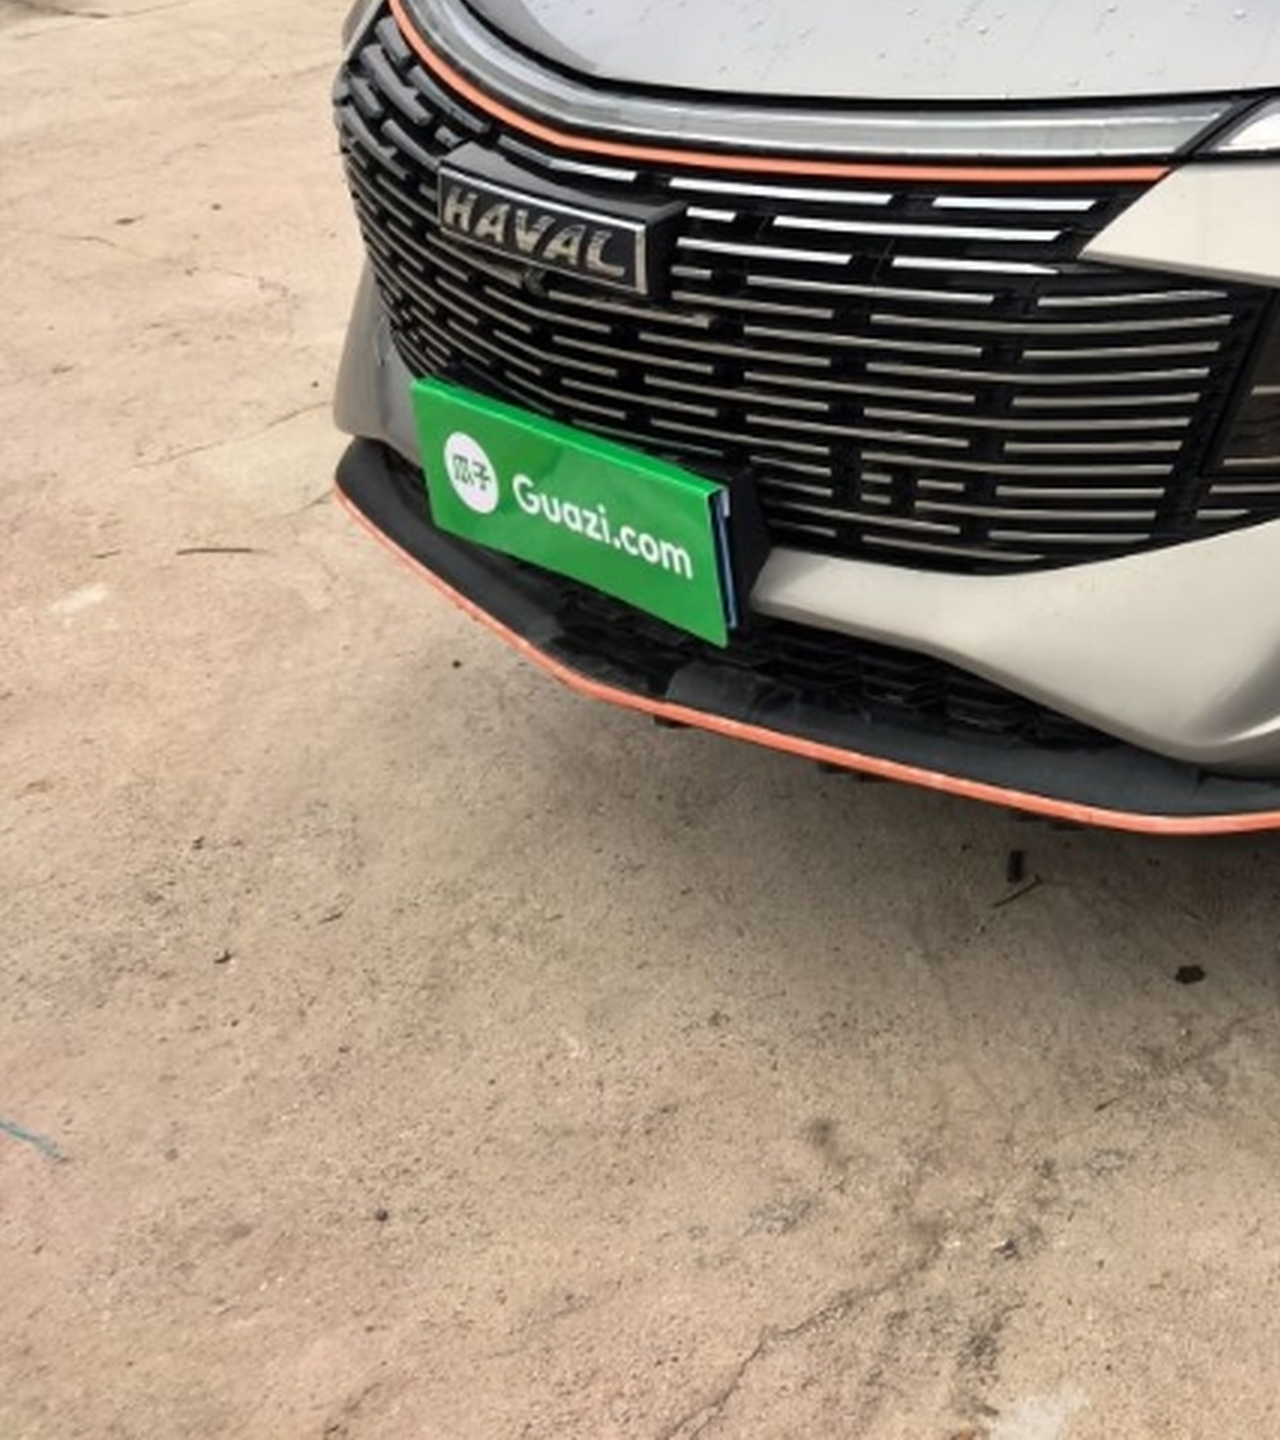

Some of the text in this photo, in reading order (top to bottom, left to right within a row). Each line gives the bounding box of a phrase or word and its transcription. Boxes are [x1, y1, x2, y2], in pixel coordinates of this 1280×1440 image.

[444, 183, 625, 278] HAVAL
[453, 454, 491, 491] 瓜子
[512, 473, 693, 580] Guazi.com
